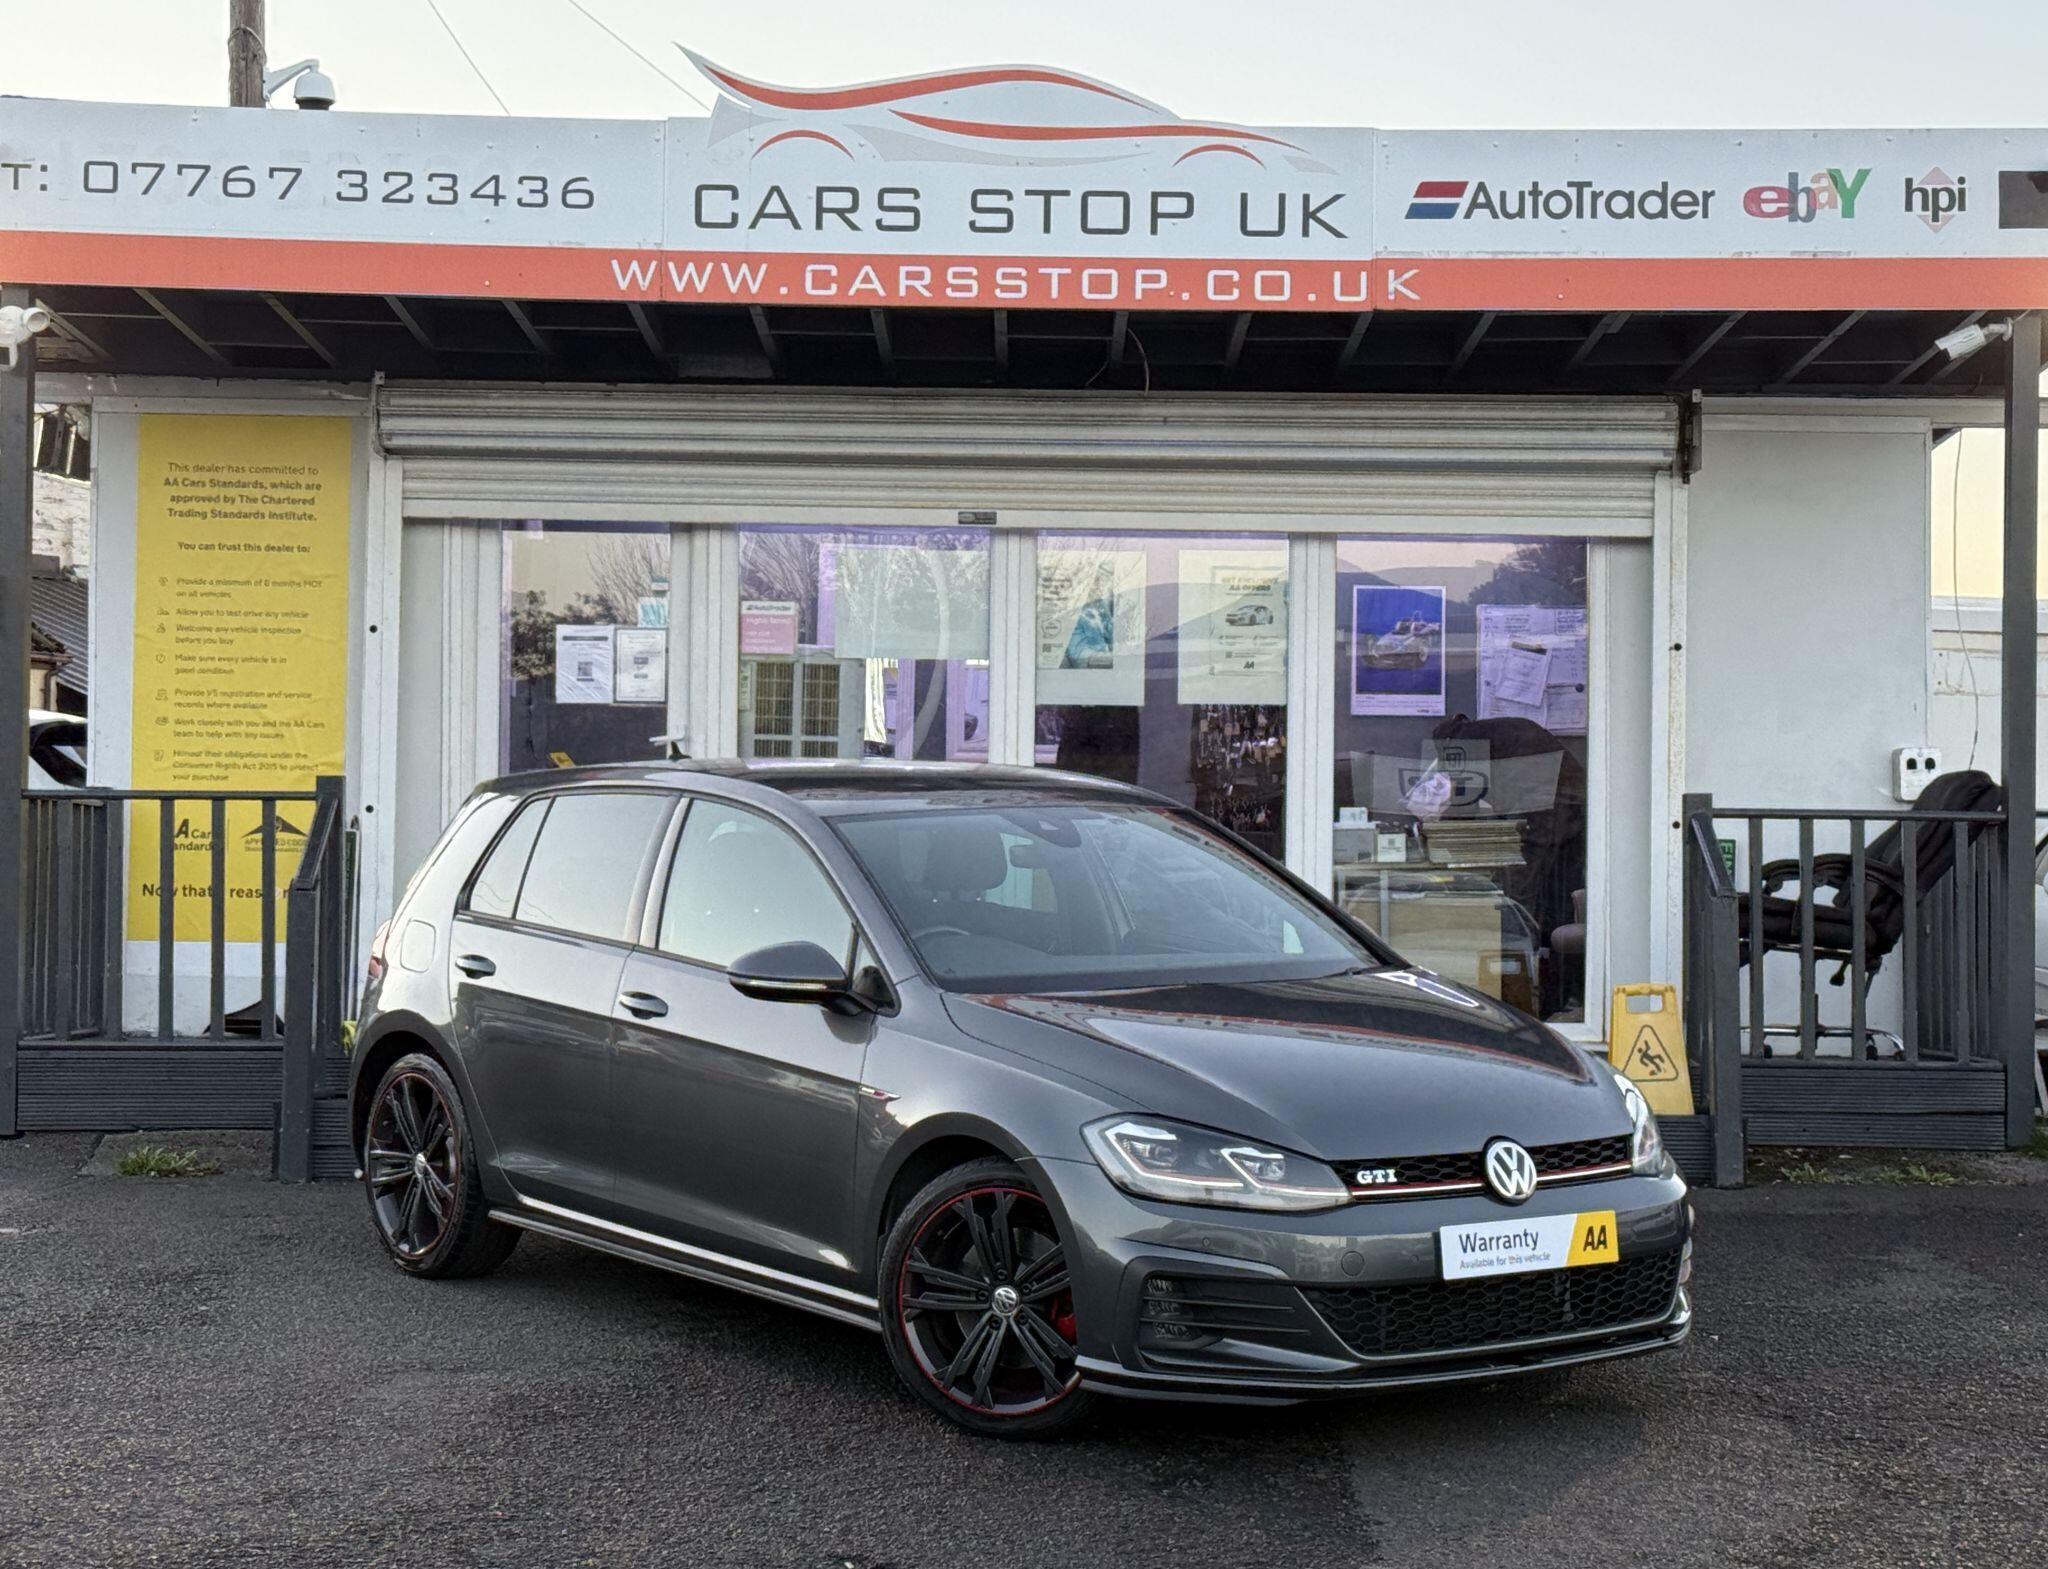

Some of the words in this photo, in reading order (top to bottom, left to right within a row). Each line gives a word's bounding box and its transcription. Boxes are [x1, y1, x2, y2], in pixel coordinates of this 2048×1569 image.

[1, 162, 49, 192] T:
[83, 160, 303, 200] 07767
[335, 169, 595, 210] 323436
[1463, 180, 1715, 221] AutoTrader
[1904, 176, 1967, 223] hpi
[693, 183, 921, 232] CARS
[969, 187, 1195, 236] STOP
[1240, 192, 1349, 239] UK
[611, 258, 1421, 302] WWW.CARSSTOP.CO.UK
[169, 463, 189, 472] This
[193, 463, 224, 473] dealer
[228, 465, 245, 473] has
[249, 465, 305, 474] committed
[164, 478, 179, 486] AA
[182, 478, 205, 487] Cars
[209, 479, 268, 490] Standards,
[270, 481, 302, 490] which
[170, 494, 219, 504] approved
[224, 495, 235, 505] by
[239, 495, 258, 504] The
[261, 495, 315, 505] Chartered
[167, 508, 207, 520] Trading
[211, 510, 265, 520] Standards
[269, 510, 316, 521] Institute.
[178, 542, 195, 550] You
[218, 543, 240, 551] trust
[244, 543, 261, 552] this
[264, 544, 294, 552] dealer
[297, 545, 310, 553] to:
[1356, 1168, 1398, 1185] GTI
[1458, 1228, 1539, 1254] Warranty
[1583, 1224, 1609, 1252] AA
[1460, 1257, 1495, 1270] Available
[1496, 1255, 1506, 1266] for
[1508, 1254, 1523, 1265] this
[1524, 1251, 1551, 1263] vehicle
